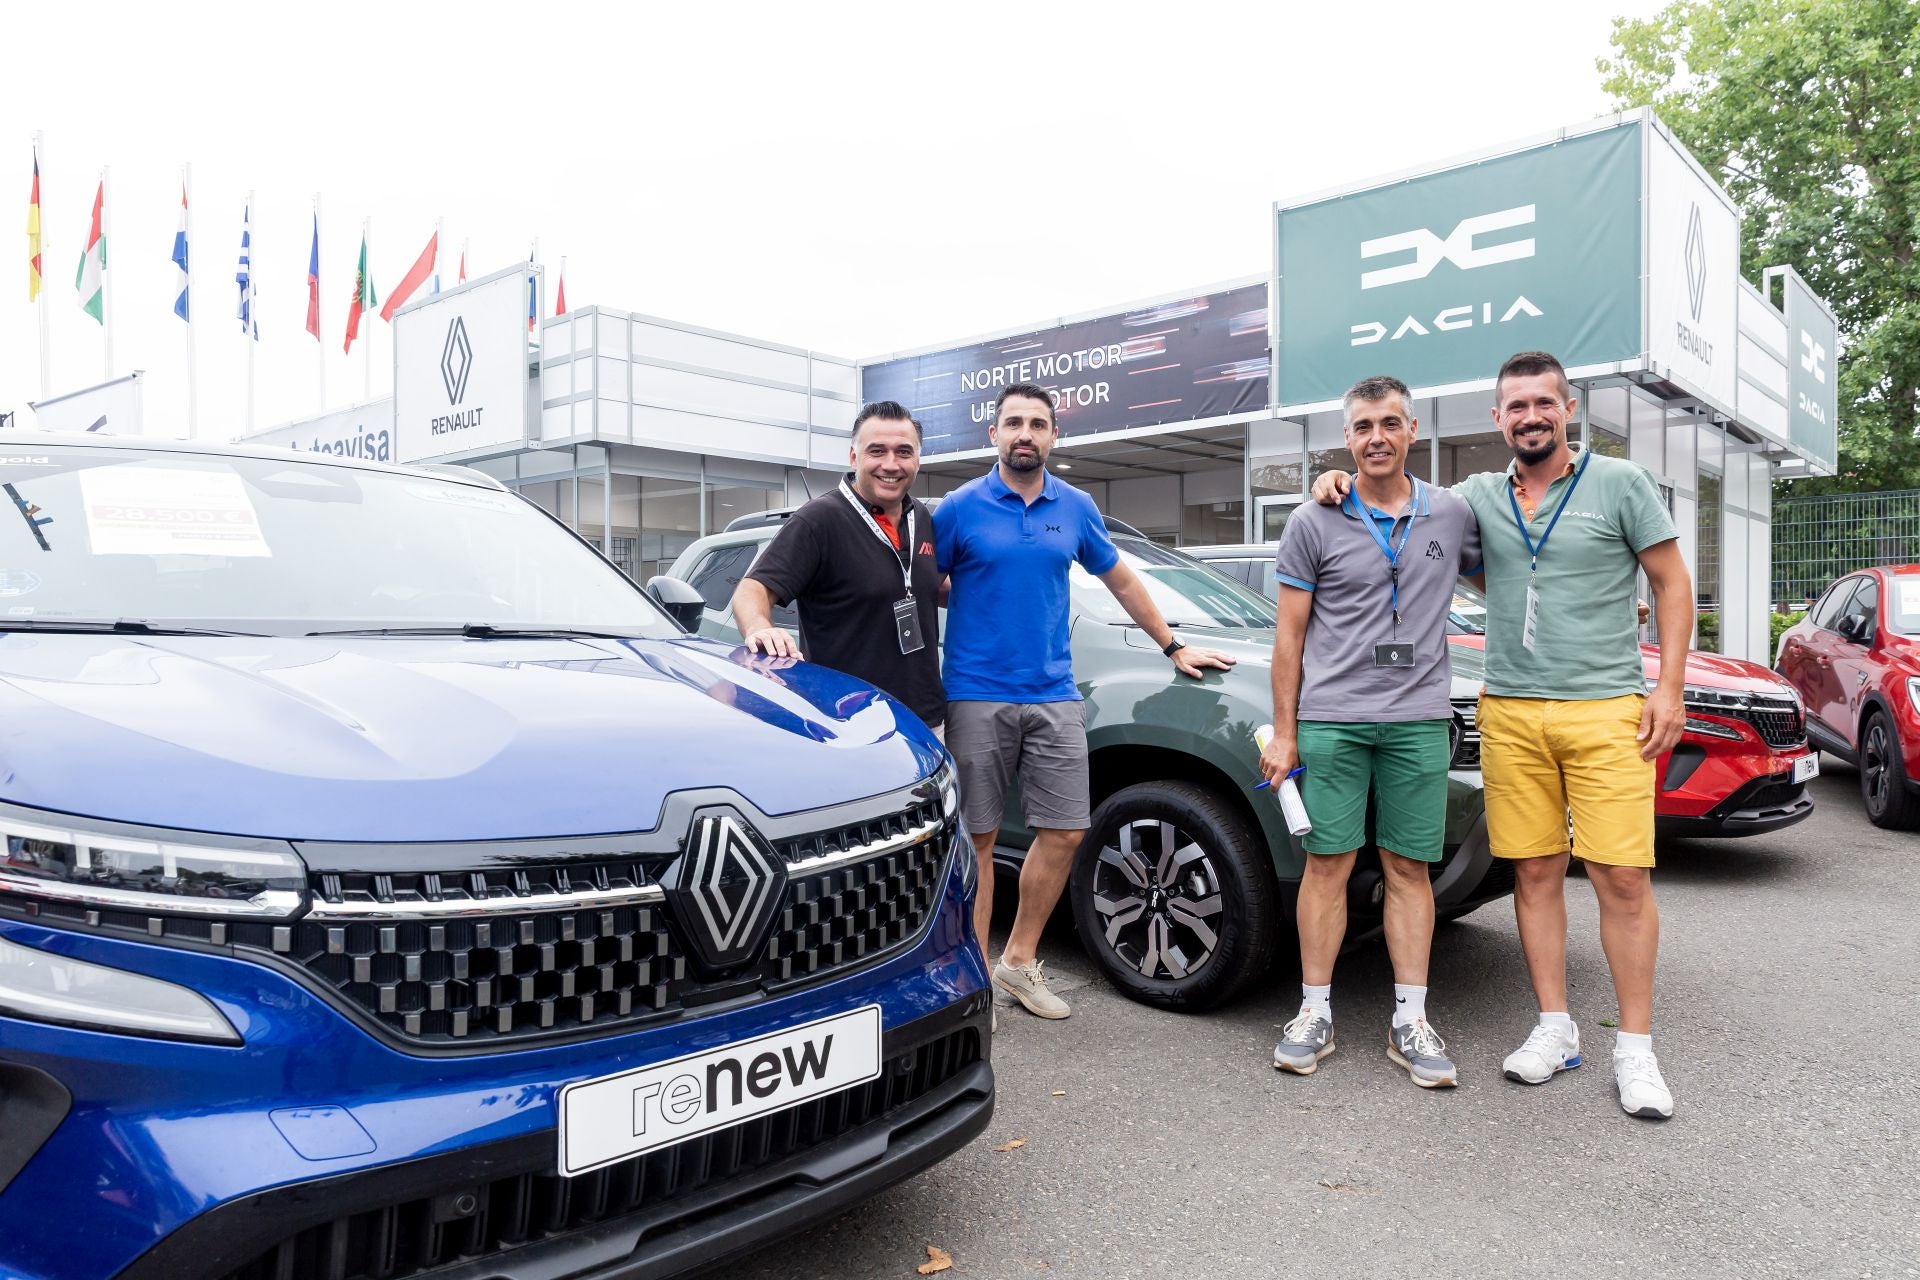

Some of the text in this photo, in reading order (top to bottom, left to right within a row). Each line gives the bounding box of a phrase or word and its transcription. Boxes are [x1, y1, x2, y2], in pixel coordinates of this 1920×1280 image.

[1351, 295, 1544, 346] DACIA
[1677, 321, 1713, 366] RENAULT
[960, 343, 1122, 393] NORTE MOTOR
[1049, 381, 1110, 410] OTOR
[1799, 391, 1826, 425] DACIA
[431, 407, 483, 436] RENAULT
[104, 506, 215, 523] 28.500
[1560, 510, 1605, 521] DACIA
[633, 1033, 834, 1138] renew
